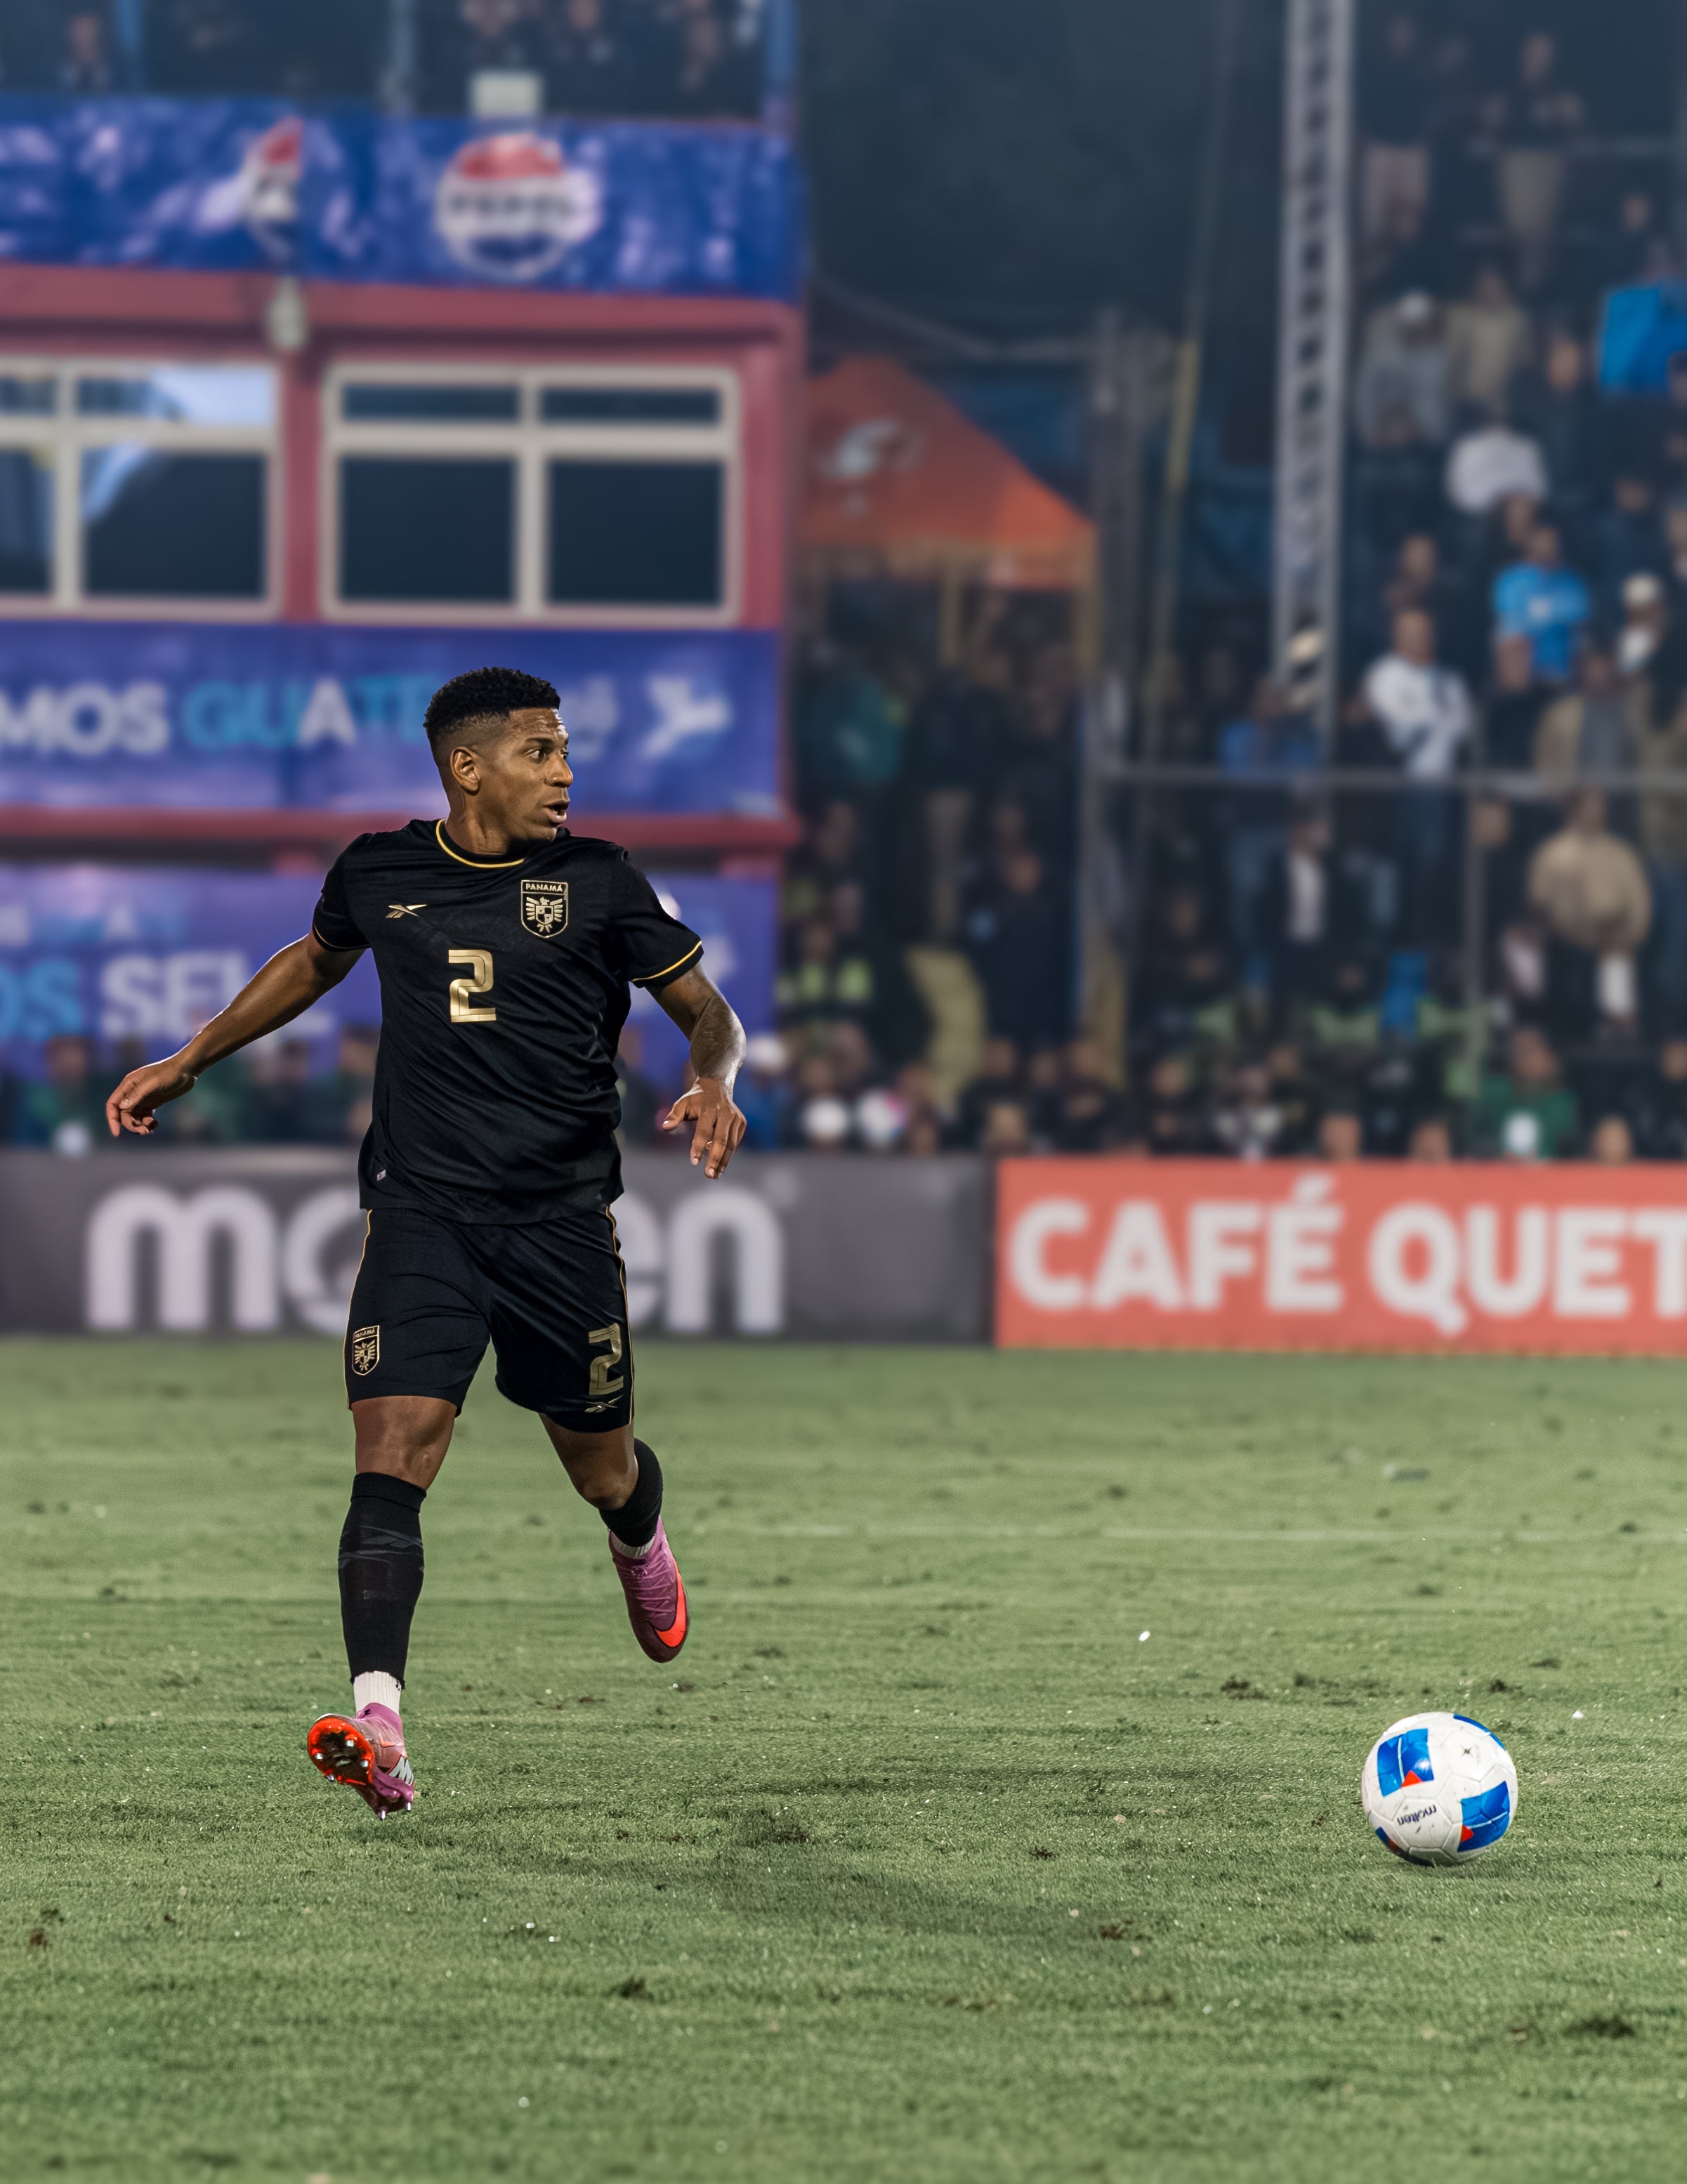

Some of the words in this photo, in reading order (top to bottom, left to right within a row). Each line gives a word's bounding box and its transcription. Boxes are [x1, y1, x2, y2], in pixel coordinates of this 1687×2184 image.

[525, 883, 563, 892] PANAMÁ
[448, 949, 497, 1023] 2
[1009, 1172, 1344, 1312] CAFÉ
[1369, 1200, 1687, 1337] QUET
[589, 1322, 624, 1395] 2
[1397, 1804, 1437, 1826] molten
